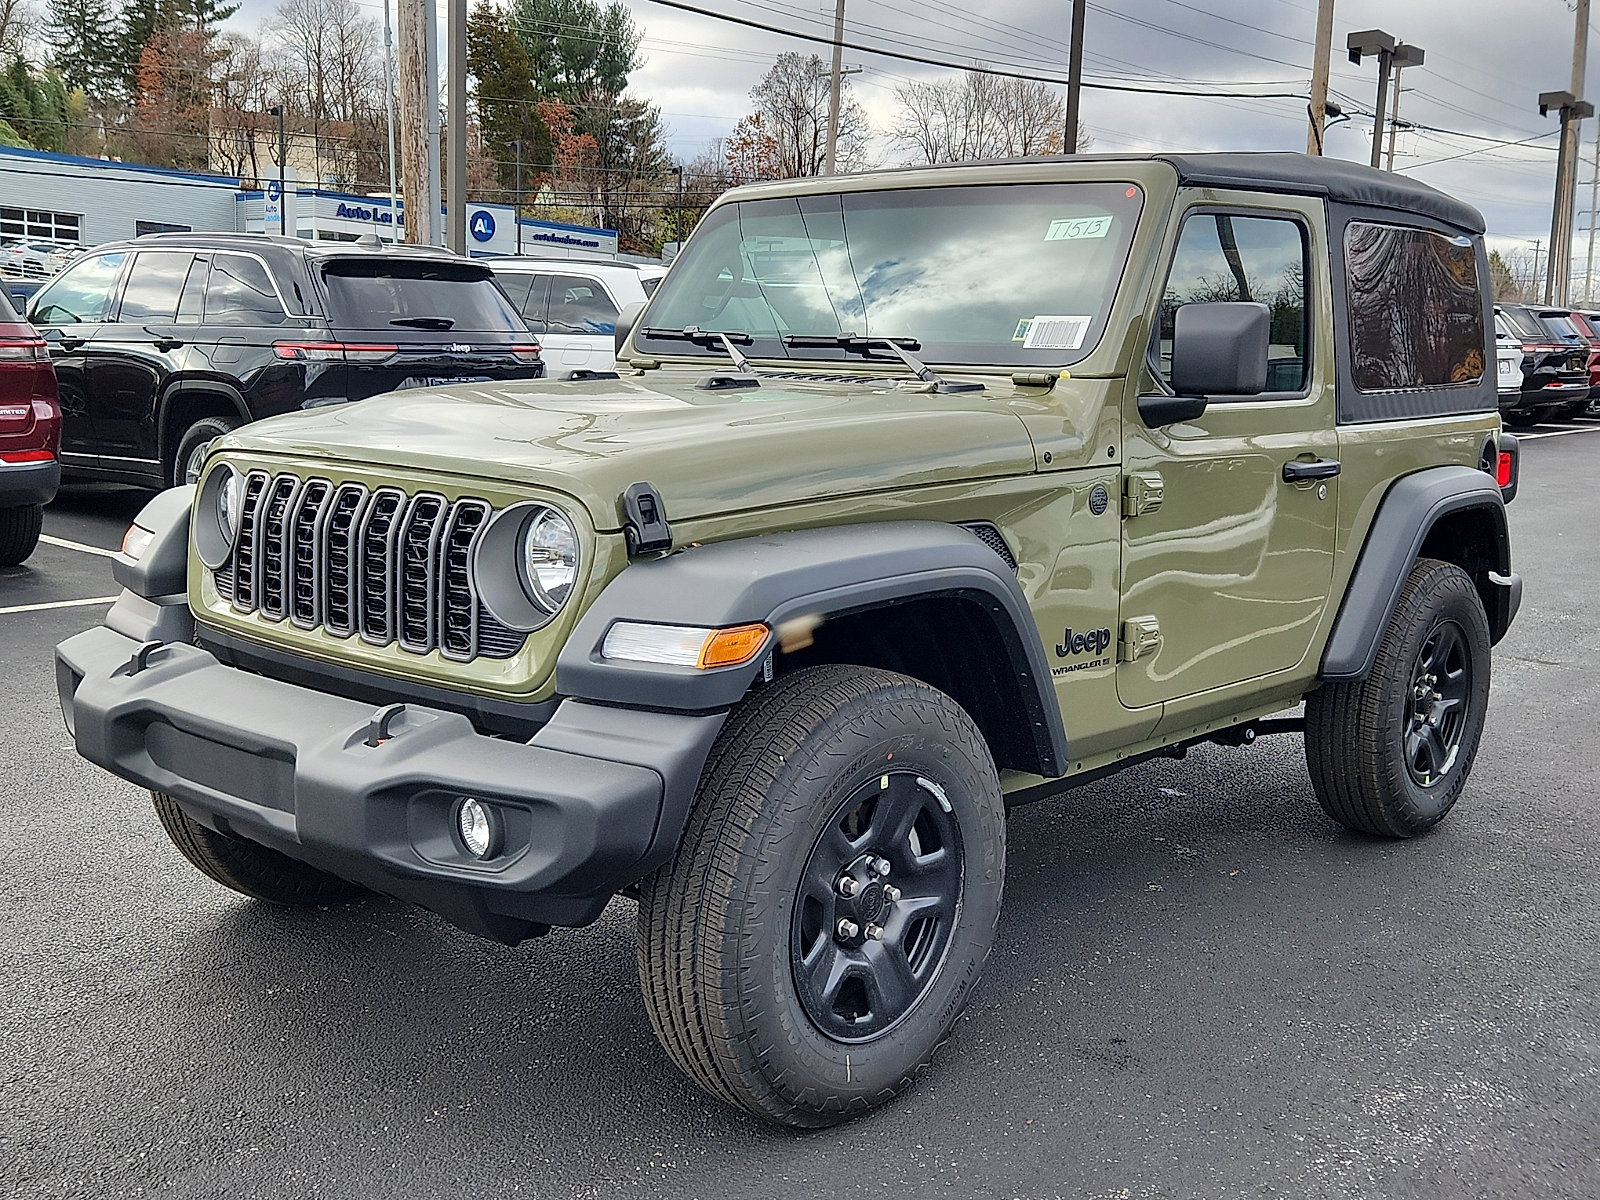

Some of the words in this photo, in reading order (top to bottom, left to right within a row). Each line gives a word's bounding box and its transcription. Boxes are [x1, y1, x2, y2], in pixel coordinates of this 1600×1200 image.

[336, 203, 371, 220] Auto
[474, 218, 492, 233] AL
[450, 342, 471, 353] Jeep
[1055, 627, 1110, 658] Jeep
[1052, 659, 1102, 675] WRANGLER
